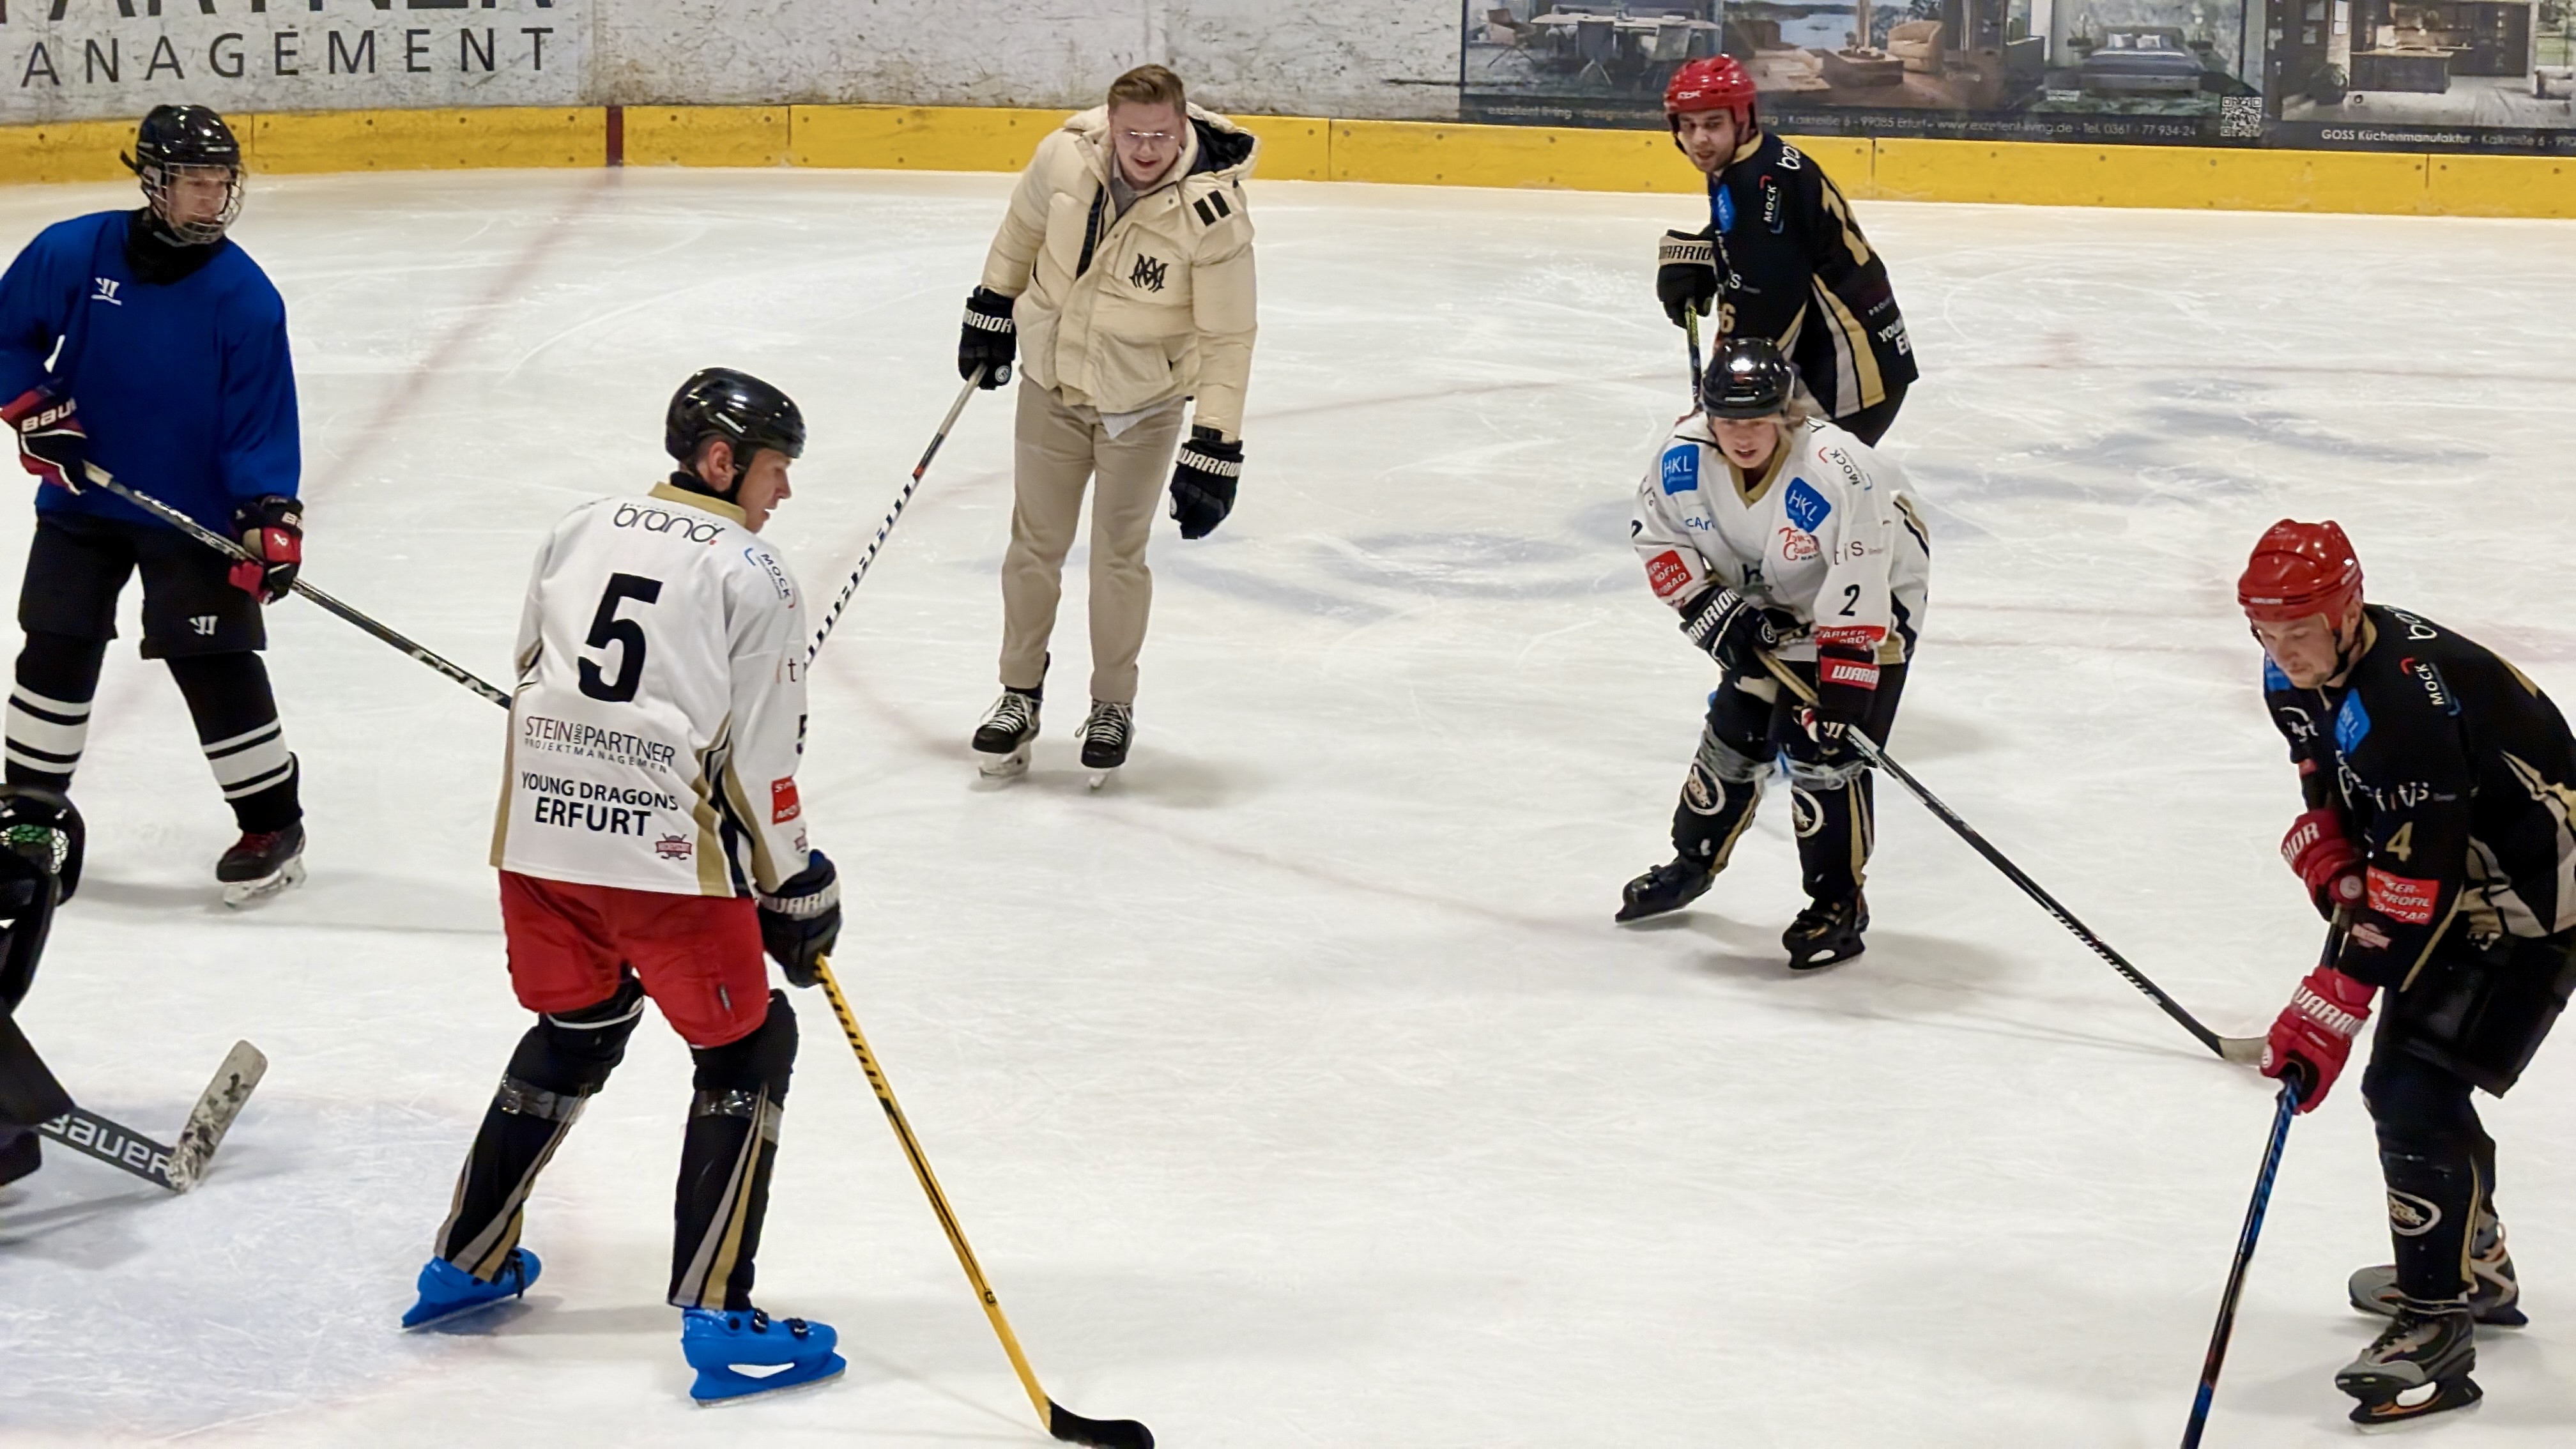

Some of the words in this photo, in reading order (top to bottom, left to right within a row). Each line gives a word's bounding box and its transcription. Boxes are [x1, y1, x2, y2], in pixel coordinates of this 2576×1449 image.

[21, 27, 554, 88] ANAGEMENT
[2321, 128, 2356, 140] GOSS
[1762, 184, 1777, 223] MOCK
[1663, 454, 1693, 479] HKL
[1830, 449, 1861, 486] MOCK
[1788, 489, 1818, 523] HKL
[760, 553, 792, 599] MOCK
[1838, 583, 1861, 617] 2
[577, 572, 664, 703] 5
[2414, 663, 2445, 707] MOCK
[525, 716, 574, 743] STEIN
[583, 725, 675, 767] PARTNER
[521, 770, 575, 797] YOUNG
[579, 781, 678, 811] DRAGONS
[534, 796, 652, 837] ERFURT
[2385, 820, 2414, 861] 4
